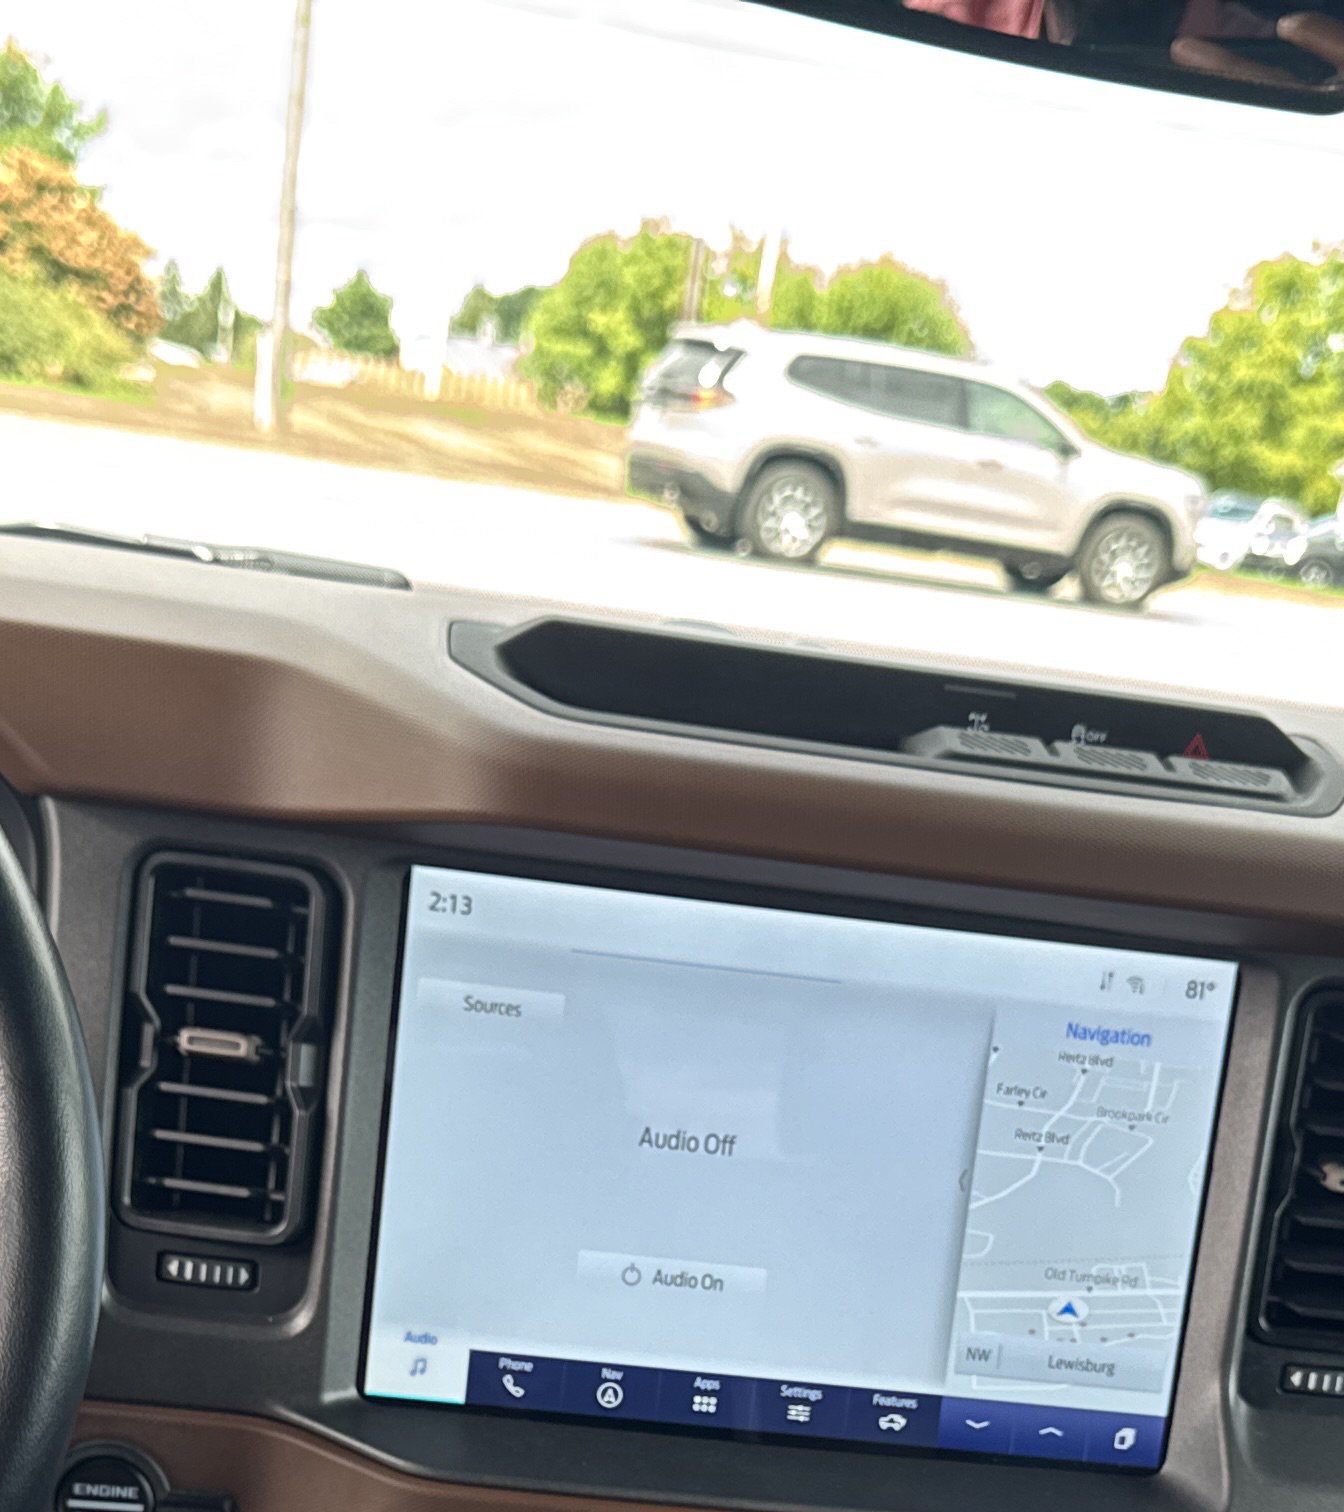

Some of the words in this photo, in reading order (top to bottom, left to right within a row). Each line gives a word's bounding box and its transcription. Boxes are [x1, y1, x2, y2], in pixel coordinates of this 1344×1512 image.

[429, 891, 472, 916] 2:13
[463, 994, 522, 1018] Sources
[1066, 1021, 1152, 1048] Navigation
[1089, 1055, 1114, 1068] Blvd
[1032, 1086, 1049, 1099] Cir
[638, 1126, 700, 1153] Audio
[703, 1133, 738, 1157] Off
[1044, 1131, 1069, 1146] Blvd
[652, 1269, 699, 1290] Audio
[701, 1274, 725, 1293] On
[404, 1330, 438, 1346] Audio
[965, 1346, 992, 1363] NW
[498, 1357, 534, 1373] Phone
[601, 1367, 624, 1381] Nav
[1047, 1354, 1116, 1378] Lewisburg
[693, 1376, 721, 1392] Apps
[780, 1384, 824, 1402] Settings
[872, 1393, 918, 1411] Features
[72, 1482, 140, 1500] ENGINE
